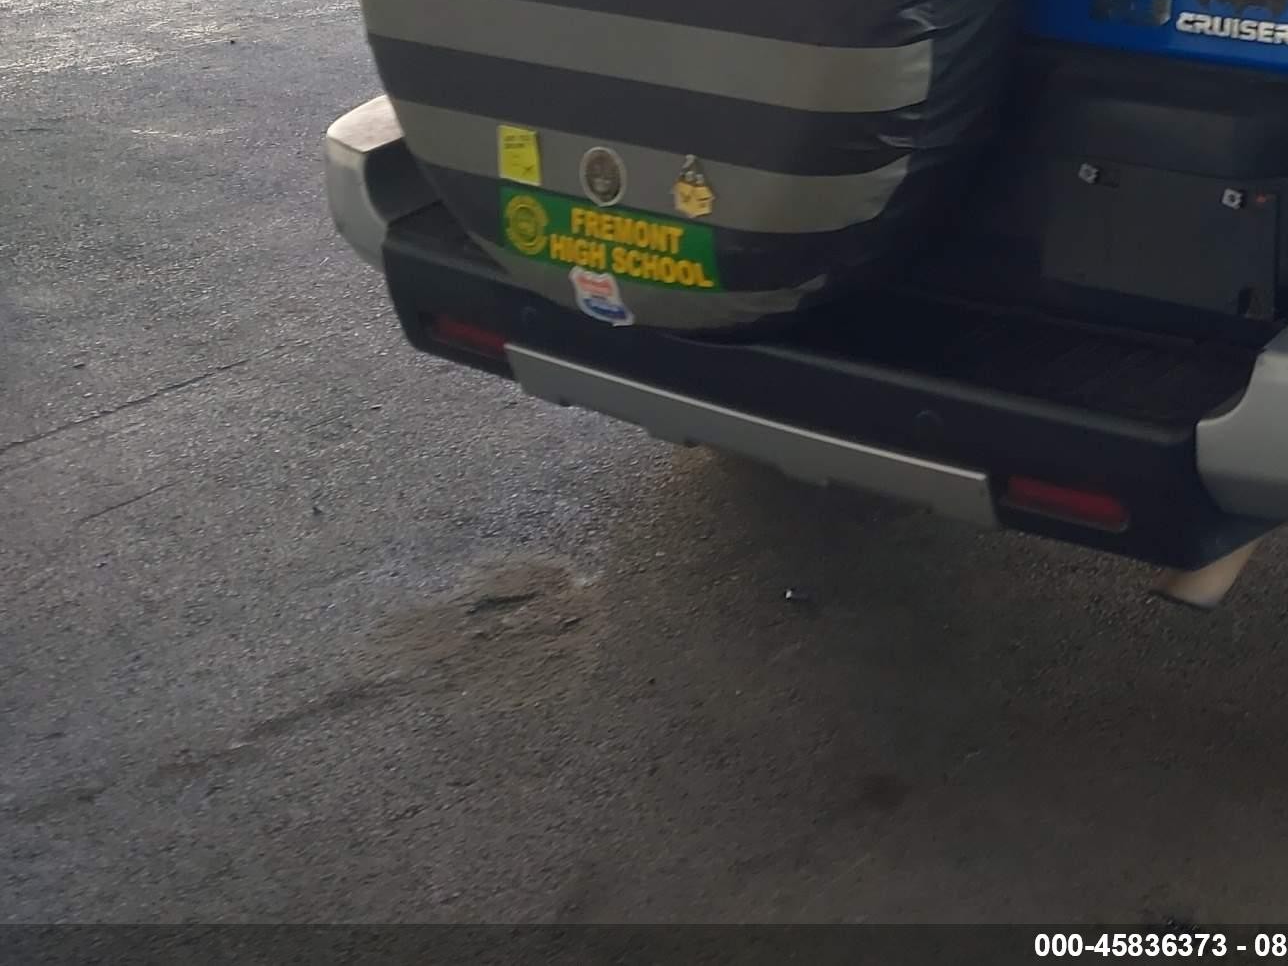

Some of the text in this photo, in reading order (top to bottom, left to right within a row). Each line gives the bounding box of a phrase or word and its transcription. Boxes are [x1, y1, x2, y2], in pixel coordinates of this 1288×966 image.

[571, 207, 683, 254] FREMONT
[550, 233, 606, 269] HIGH
[612, 247, 714, 288] SCHOOL
